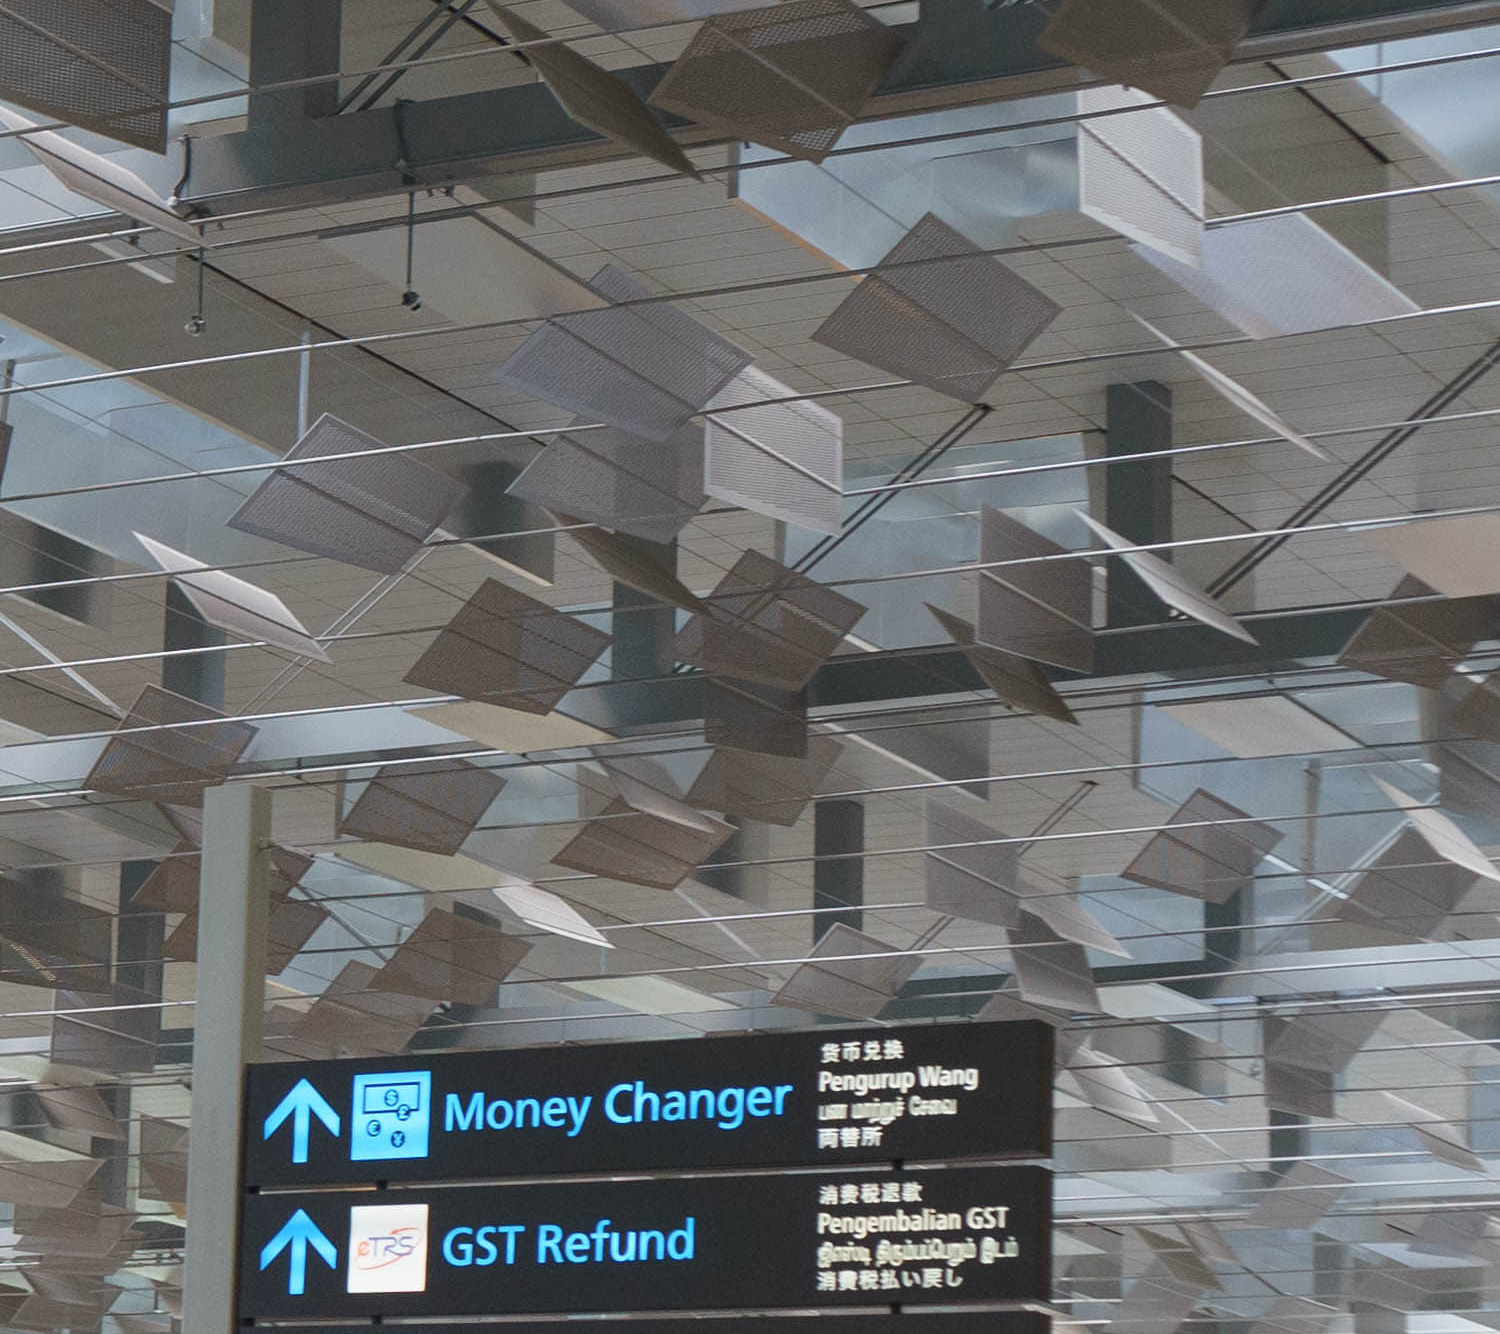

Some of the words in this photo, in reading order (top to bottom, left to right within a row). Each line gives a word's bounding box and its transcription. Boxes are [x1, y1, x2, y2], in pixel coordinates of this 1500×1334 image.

[820, 1039, 904, 1063] 货币兑换
[818, 1070, 915, 1095] Pengurup
[917, 1065, 979, 1091] Wang
[444, 1092, 593, 1137] Money
[604, 1080, 794, 1130] Changer
[817, 1126, 883, 1149] 両替所
[817, 1208, 962, 1239] Pengembalian
[966, 1206, 1010, 1230] GST
[442, 1225, 526, 1267] GST
[536, 1216, 695, 1264] Refund
